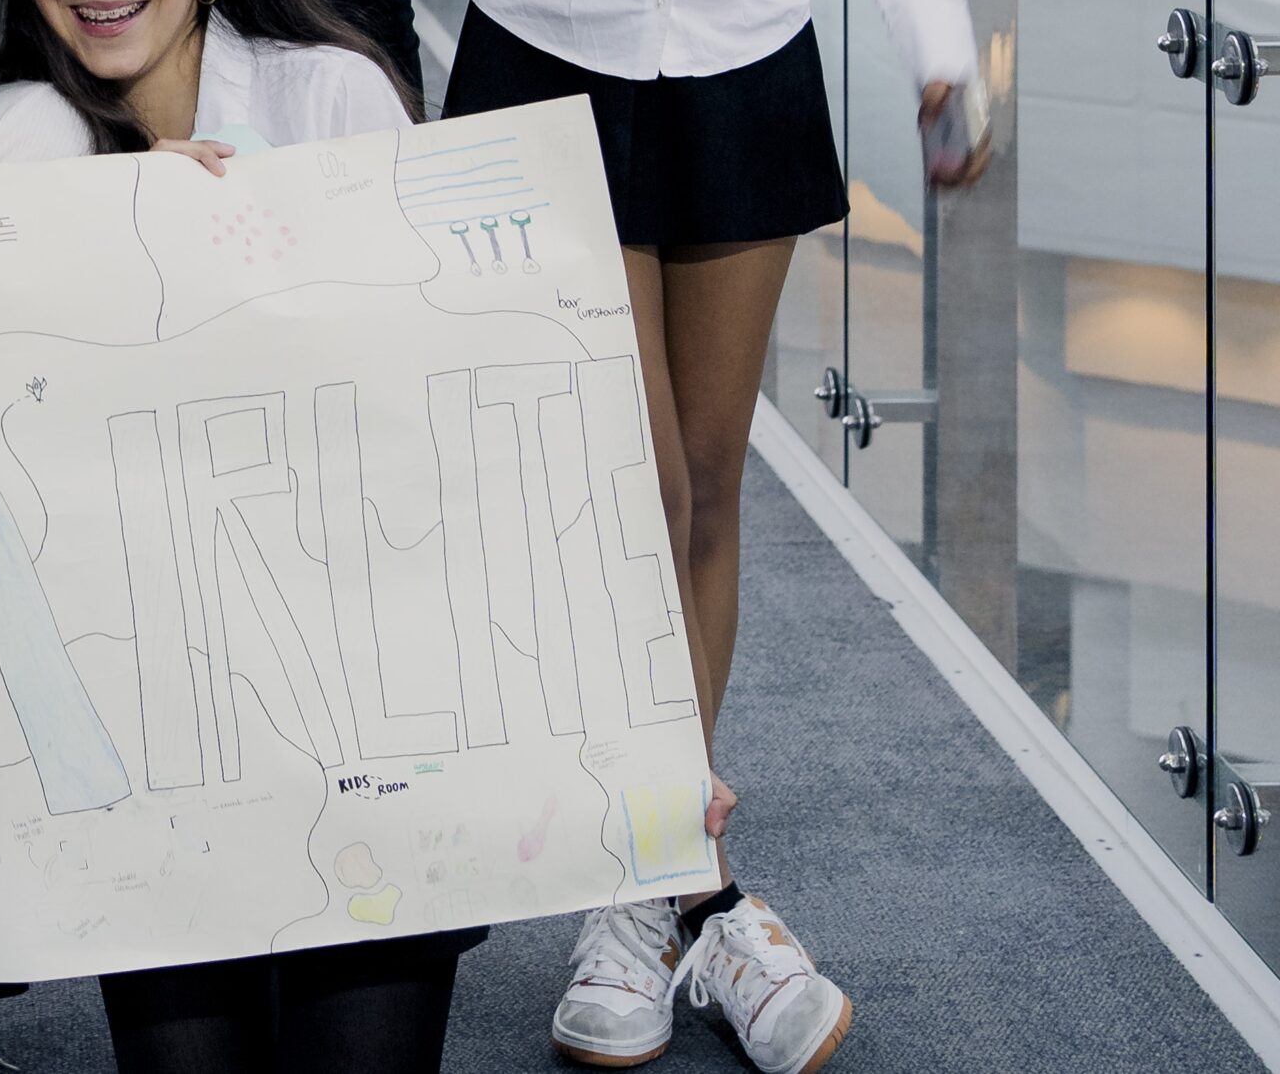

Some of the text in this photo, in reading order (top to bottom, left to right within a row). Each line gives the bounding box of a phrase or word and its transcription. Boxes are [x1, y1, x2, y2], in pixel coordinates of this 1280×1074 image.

[556, 288, 582, 309] bar
[338, 774, 410, 797] KIDS ROOM
